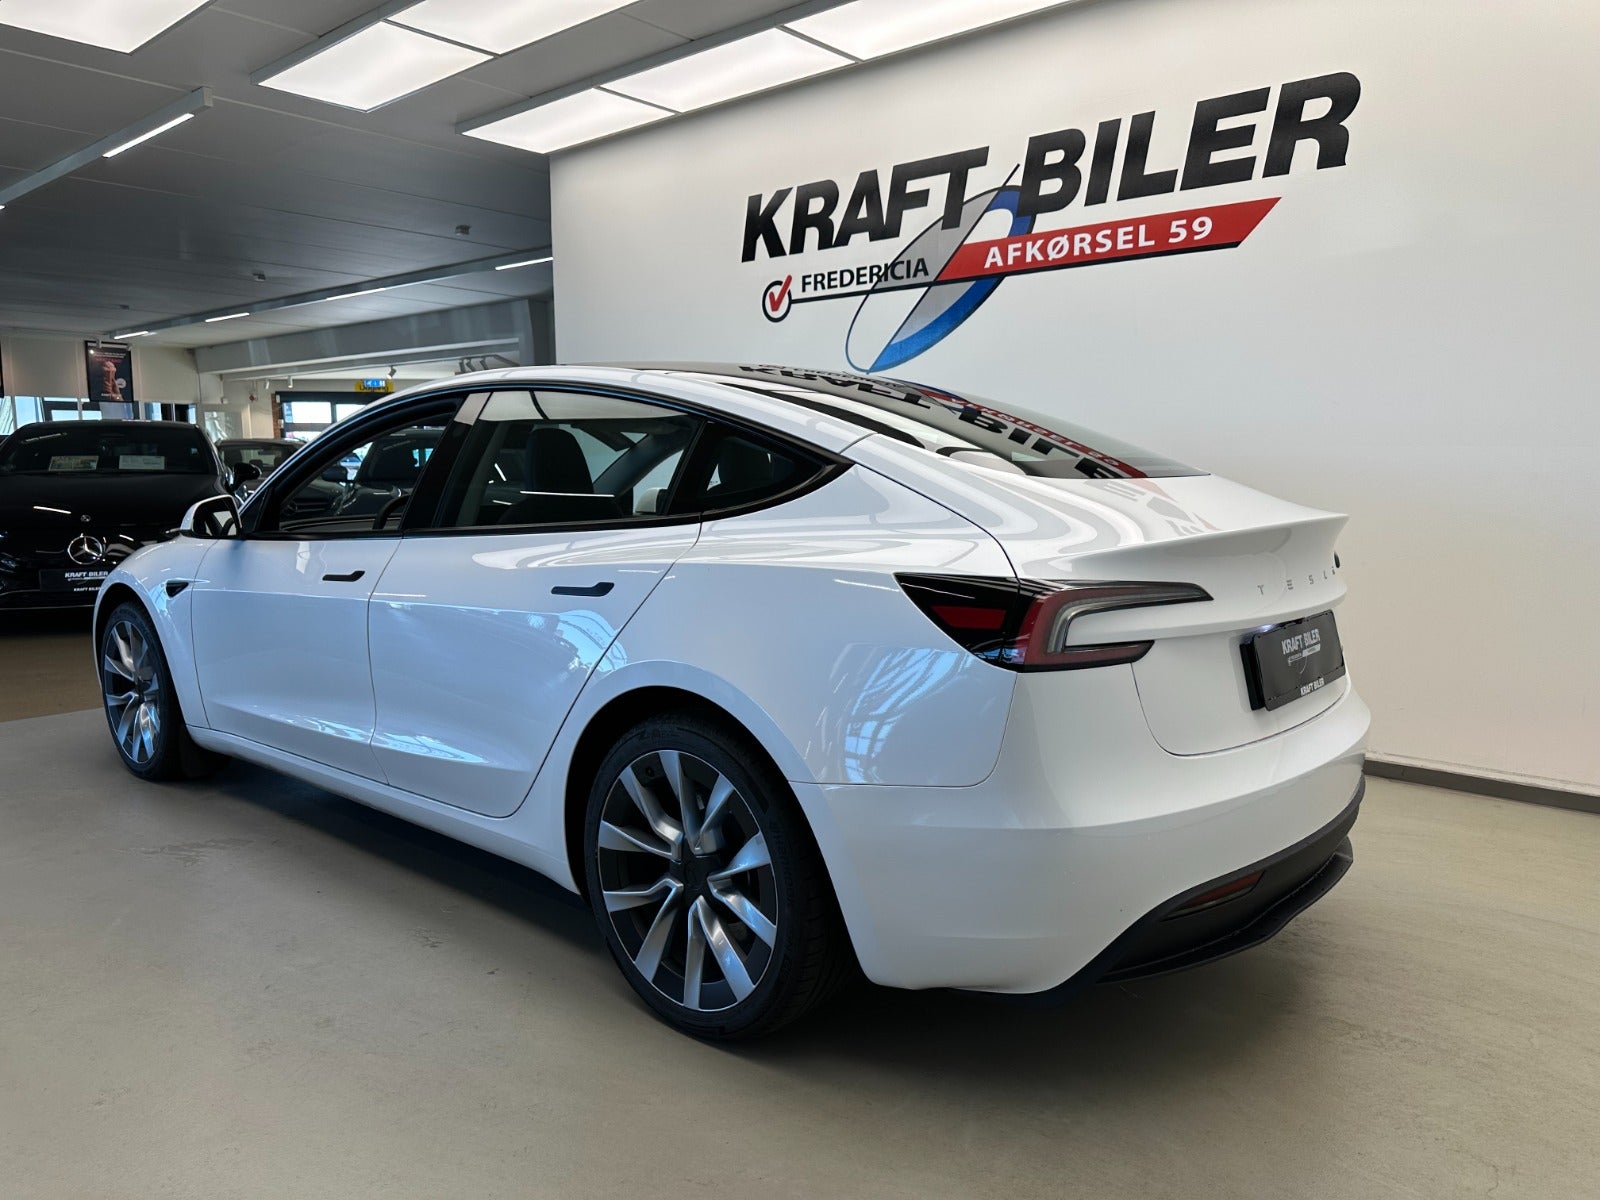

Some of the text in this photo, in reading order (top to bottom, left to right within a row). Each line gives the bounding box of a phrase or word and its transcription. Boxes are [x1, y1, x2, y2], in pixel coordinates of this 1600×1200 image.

[741, 71, 1362, 263] KRAFT BILER
[983, 215, 1214, 270] AFKØRSEL 59
[800, 257, 930, 293] FREDERICIA
[1282, 629, 1320, 655] KRAFT BILER
[1300, 677, 1325, 696] KRAFT BILER
